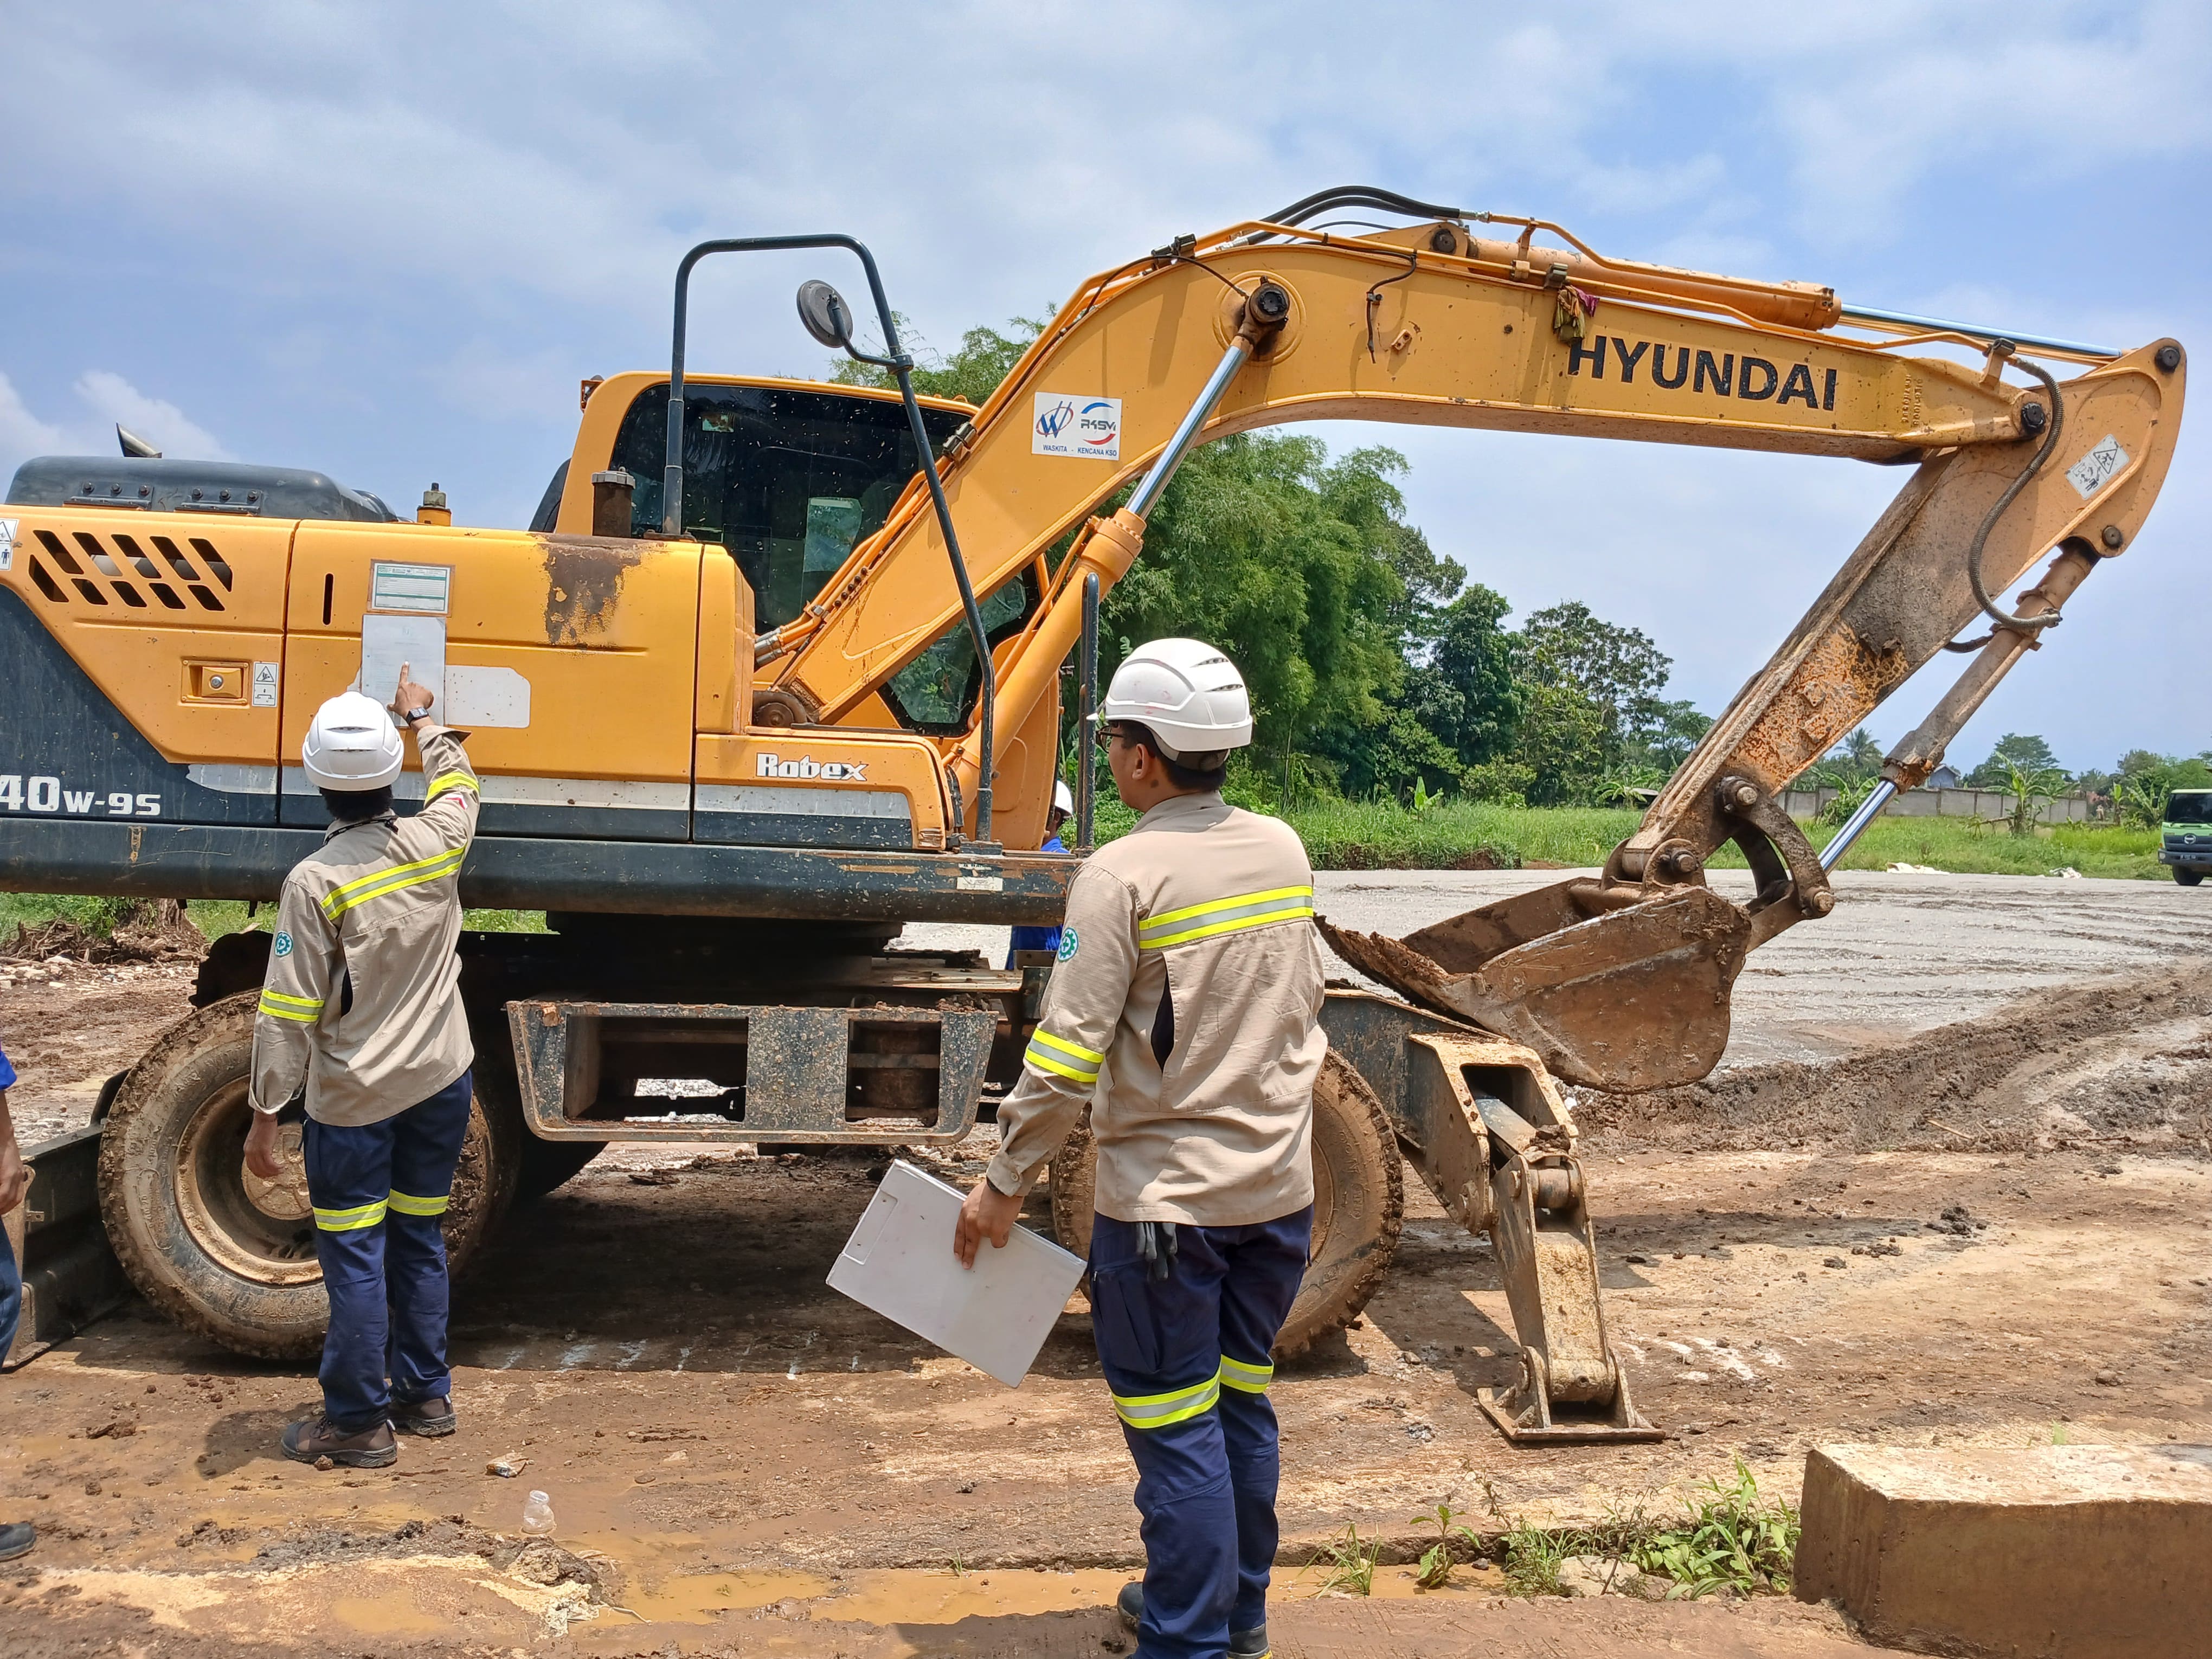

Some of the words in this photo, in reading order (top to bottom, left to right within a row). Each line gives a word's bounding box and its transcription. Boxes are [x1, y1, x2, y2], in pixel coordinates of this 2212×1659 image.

[1567, 335, 1838, 411] HYUNDAI
[1077, 447, 1104, 455] KENCANA
[756, 753, 869, 781] Robex
